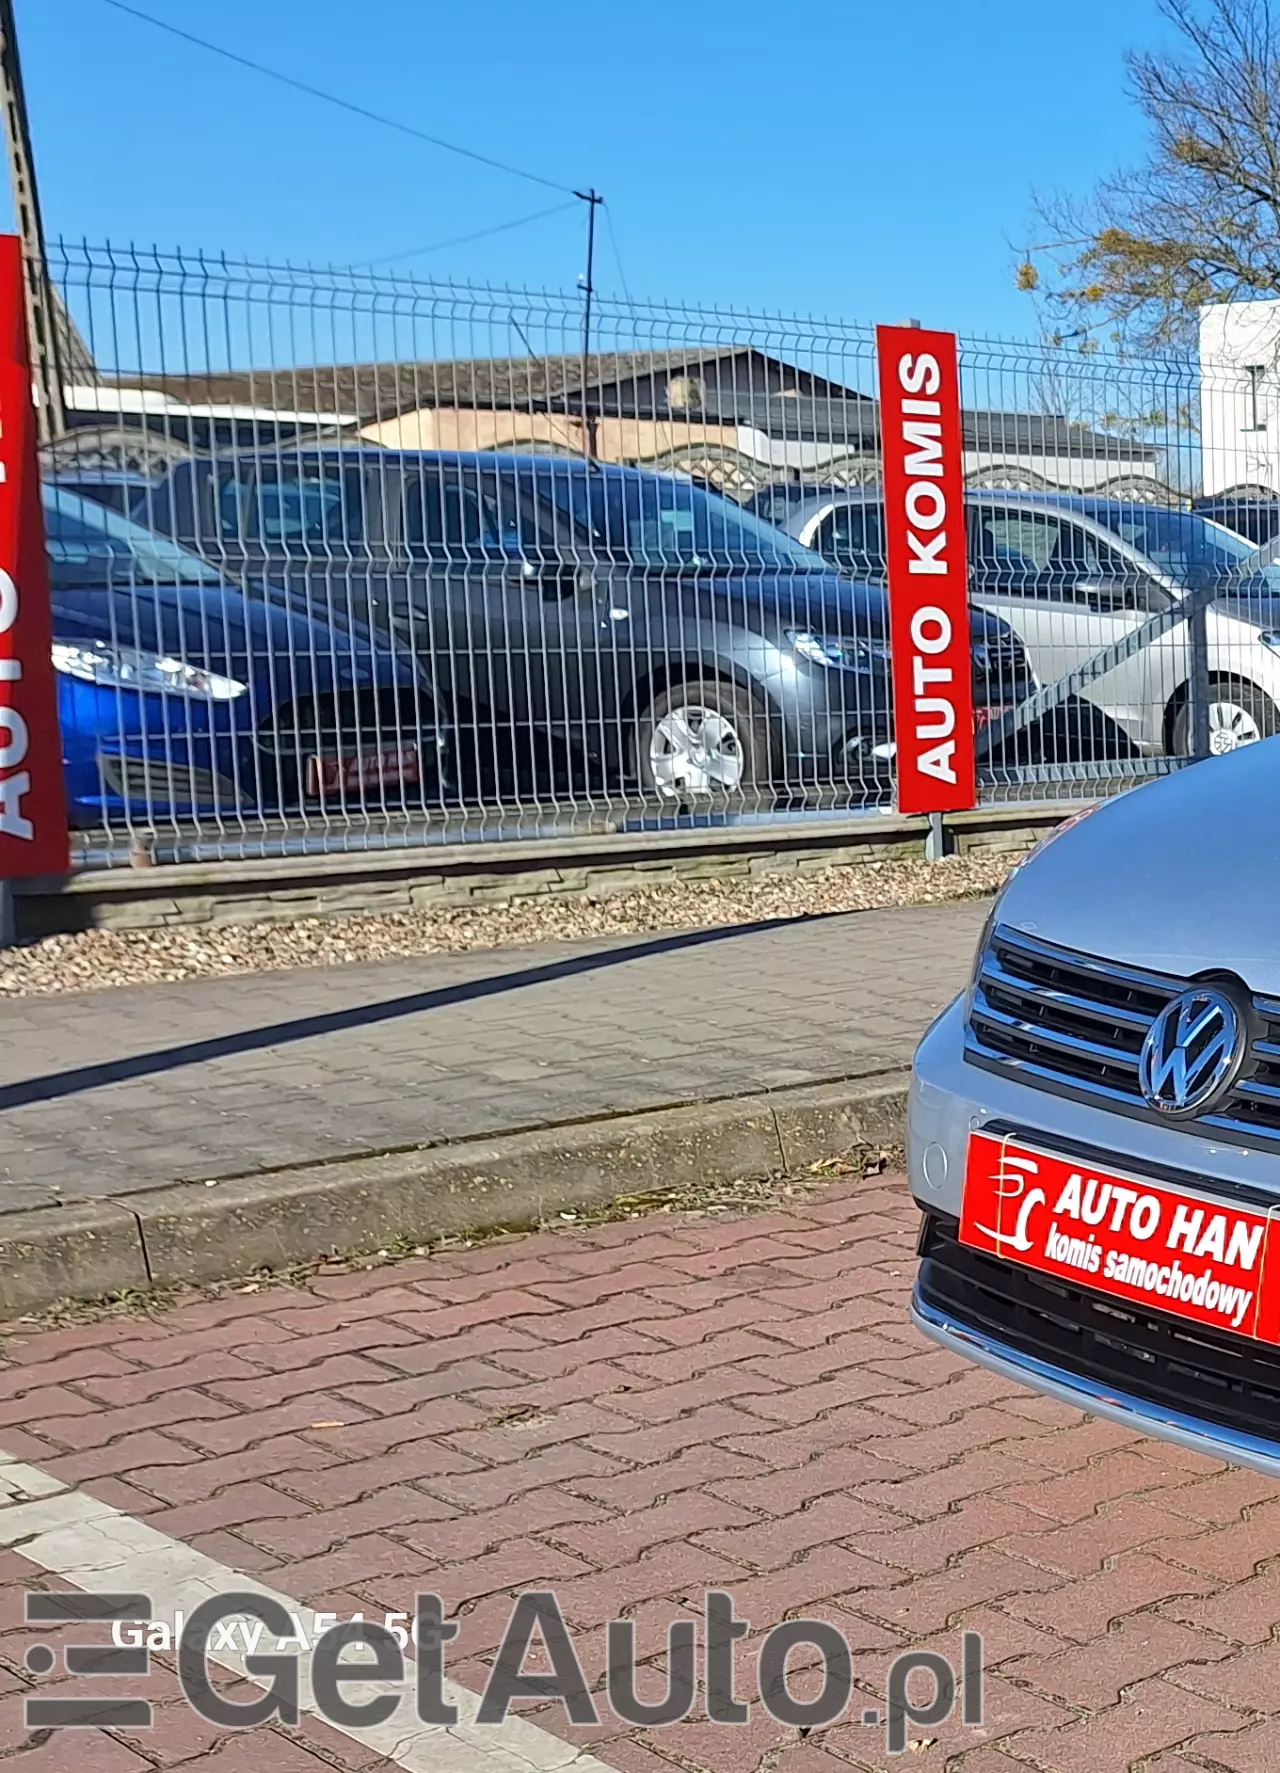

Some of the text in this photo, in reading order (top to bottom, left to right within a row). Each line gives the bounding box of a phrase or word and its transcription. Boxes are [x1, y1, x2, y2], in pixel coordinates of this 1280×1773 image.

[899, 352, 957, 785] AUTO KOMIS
[1053, 1173, 1265, 1270] AUTO HAN
[1044, 1222, 1254, 1328] komis samochodowy
